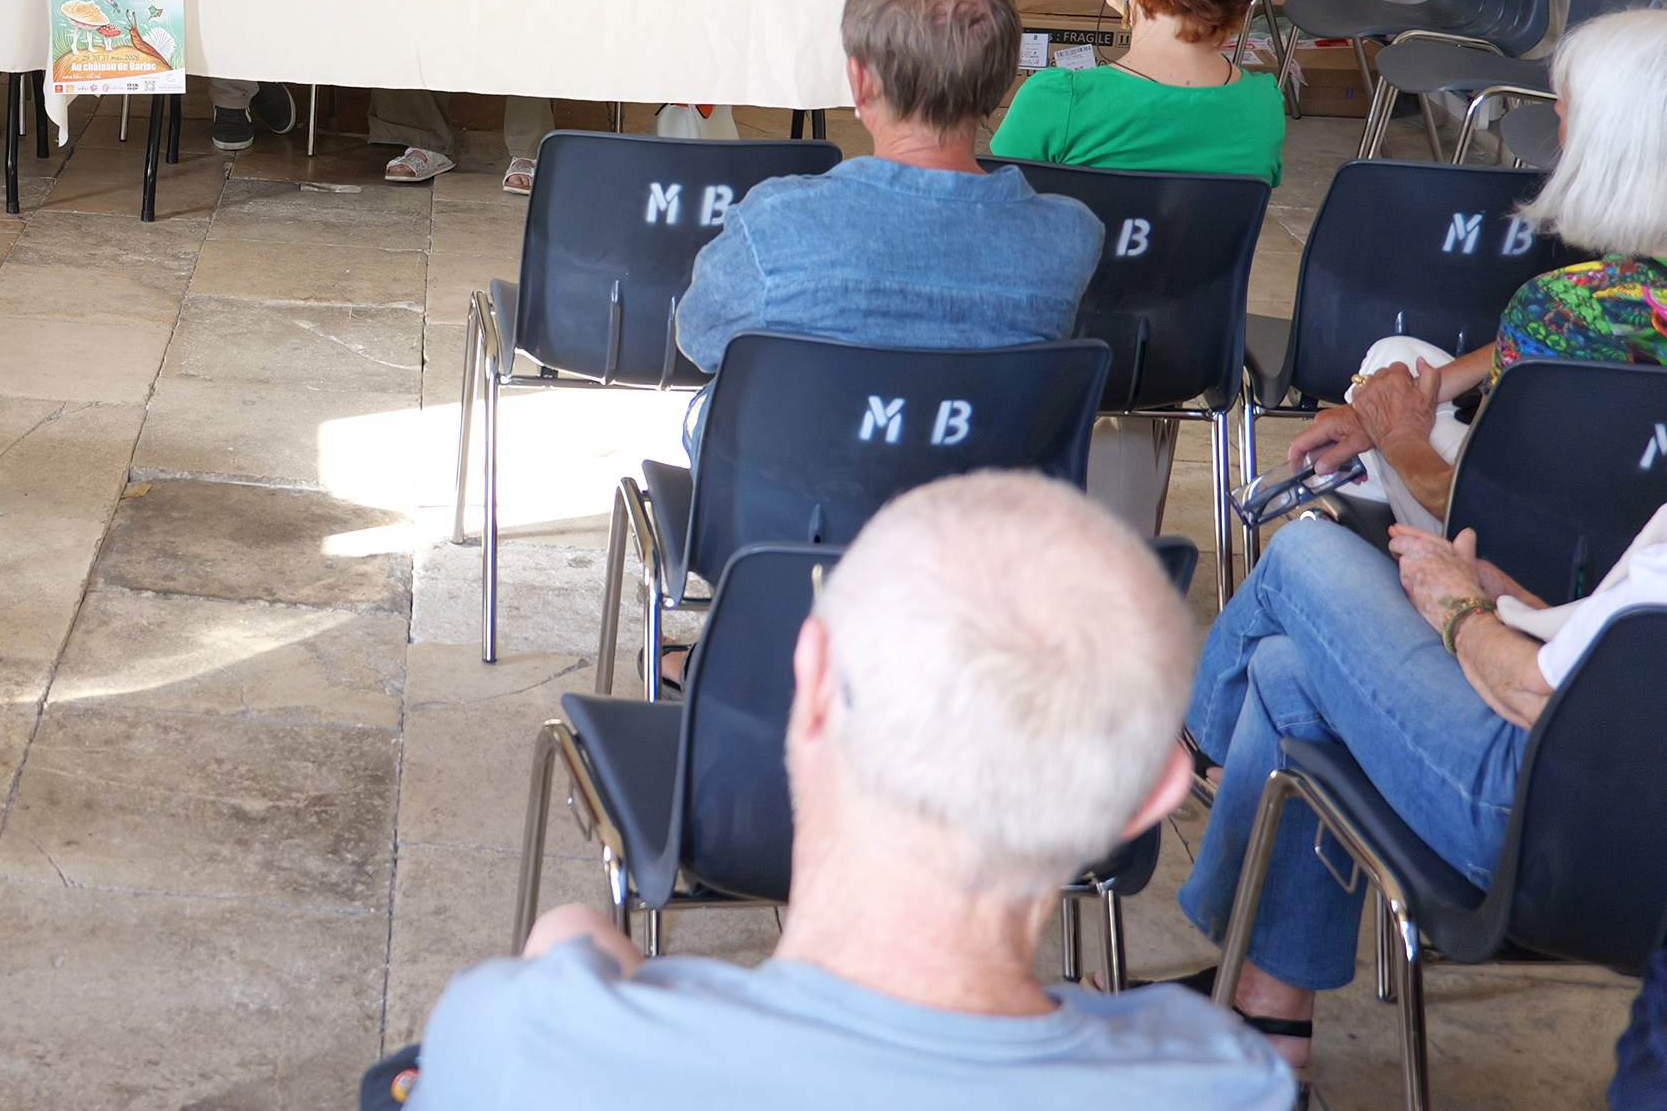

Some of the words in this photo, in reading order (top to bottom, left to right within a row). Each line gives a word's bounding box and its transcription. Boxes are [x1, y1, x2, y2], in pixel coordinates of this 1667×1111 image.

[71, 62, 82, 71] Au
[83, 62, 117, 71] château
[118, 62, 129, 71] de
[129, 62, 157, 72] Barjac
[124, 53, 140, 61] 2026
[645, 182, 682, 224] M
[701, 184, 734, 226] B
[1116, 218, 1151, 257] B
[1442, 212, 1482, 254] M
[1501, 216, 1535, 255] B
[859, 395, 905, 444] M
[931, 399, 972, 445] B
